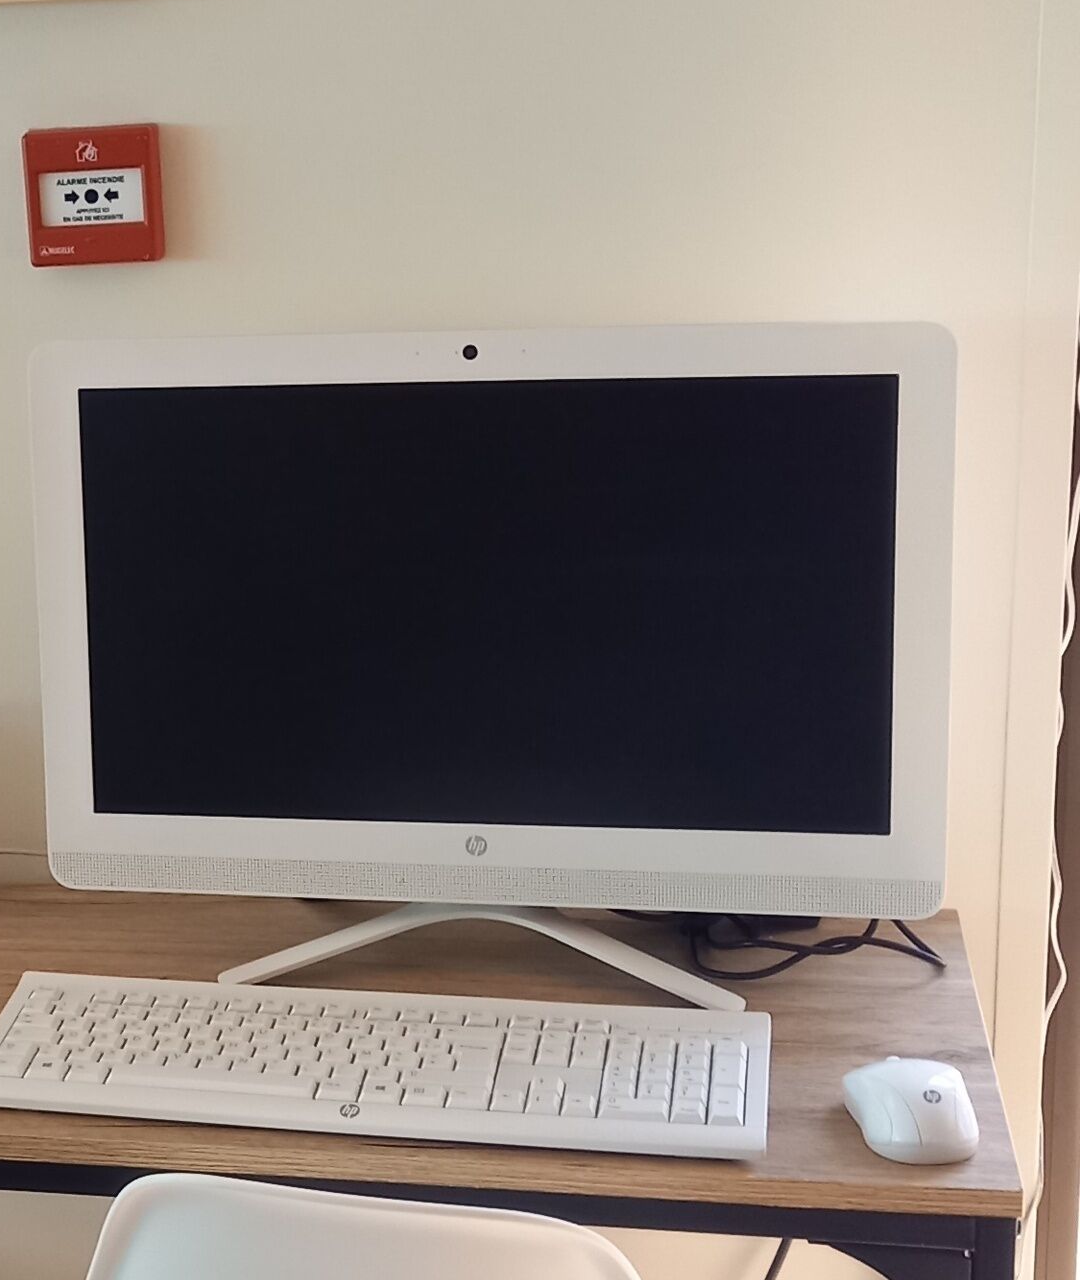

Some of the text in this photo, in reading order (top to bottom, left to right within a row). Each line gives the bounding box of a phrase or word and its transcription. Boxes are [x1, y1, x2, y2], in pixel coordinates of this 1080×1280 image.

[56, 175, 124, 186] ALARME INCENDIE
[467, 836, 486, 856] hp
